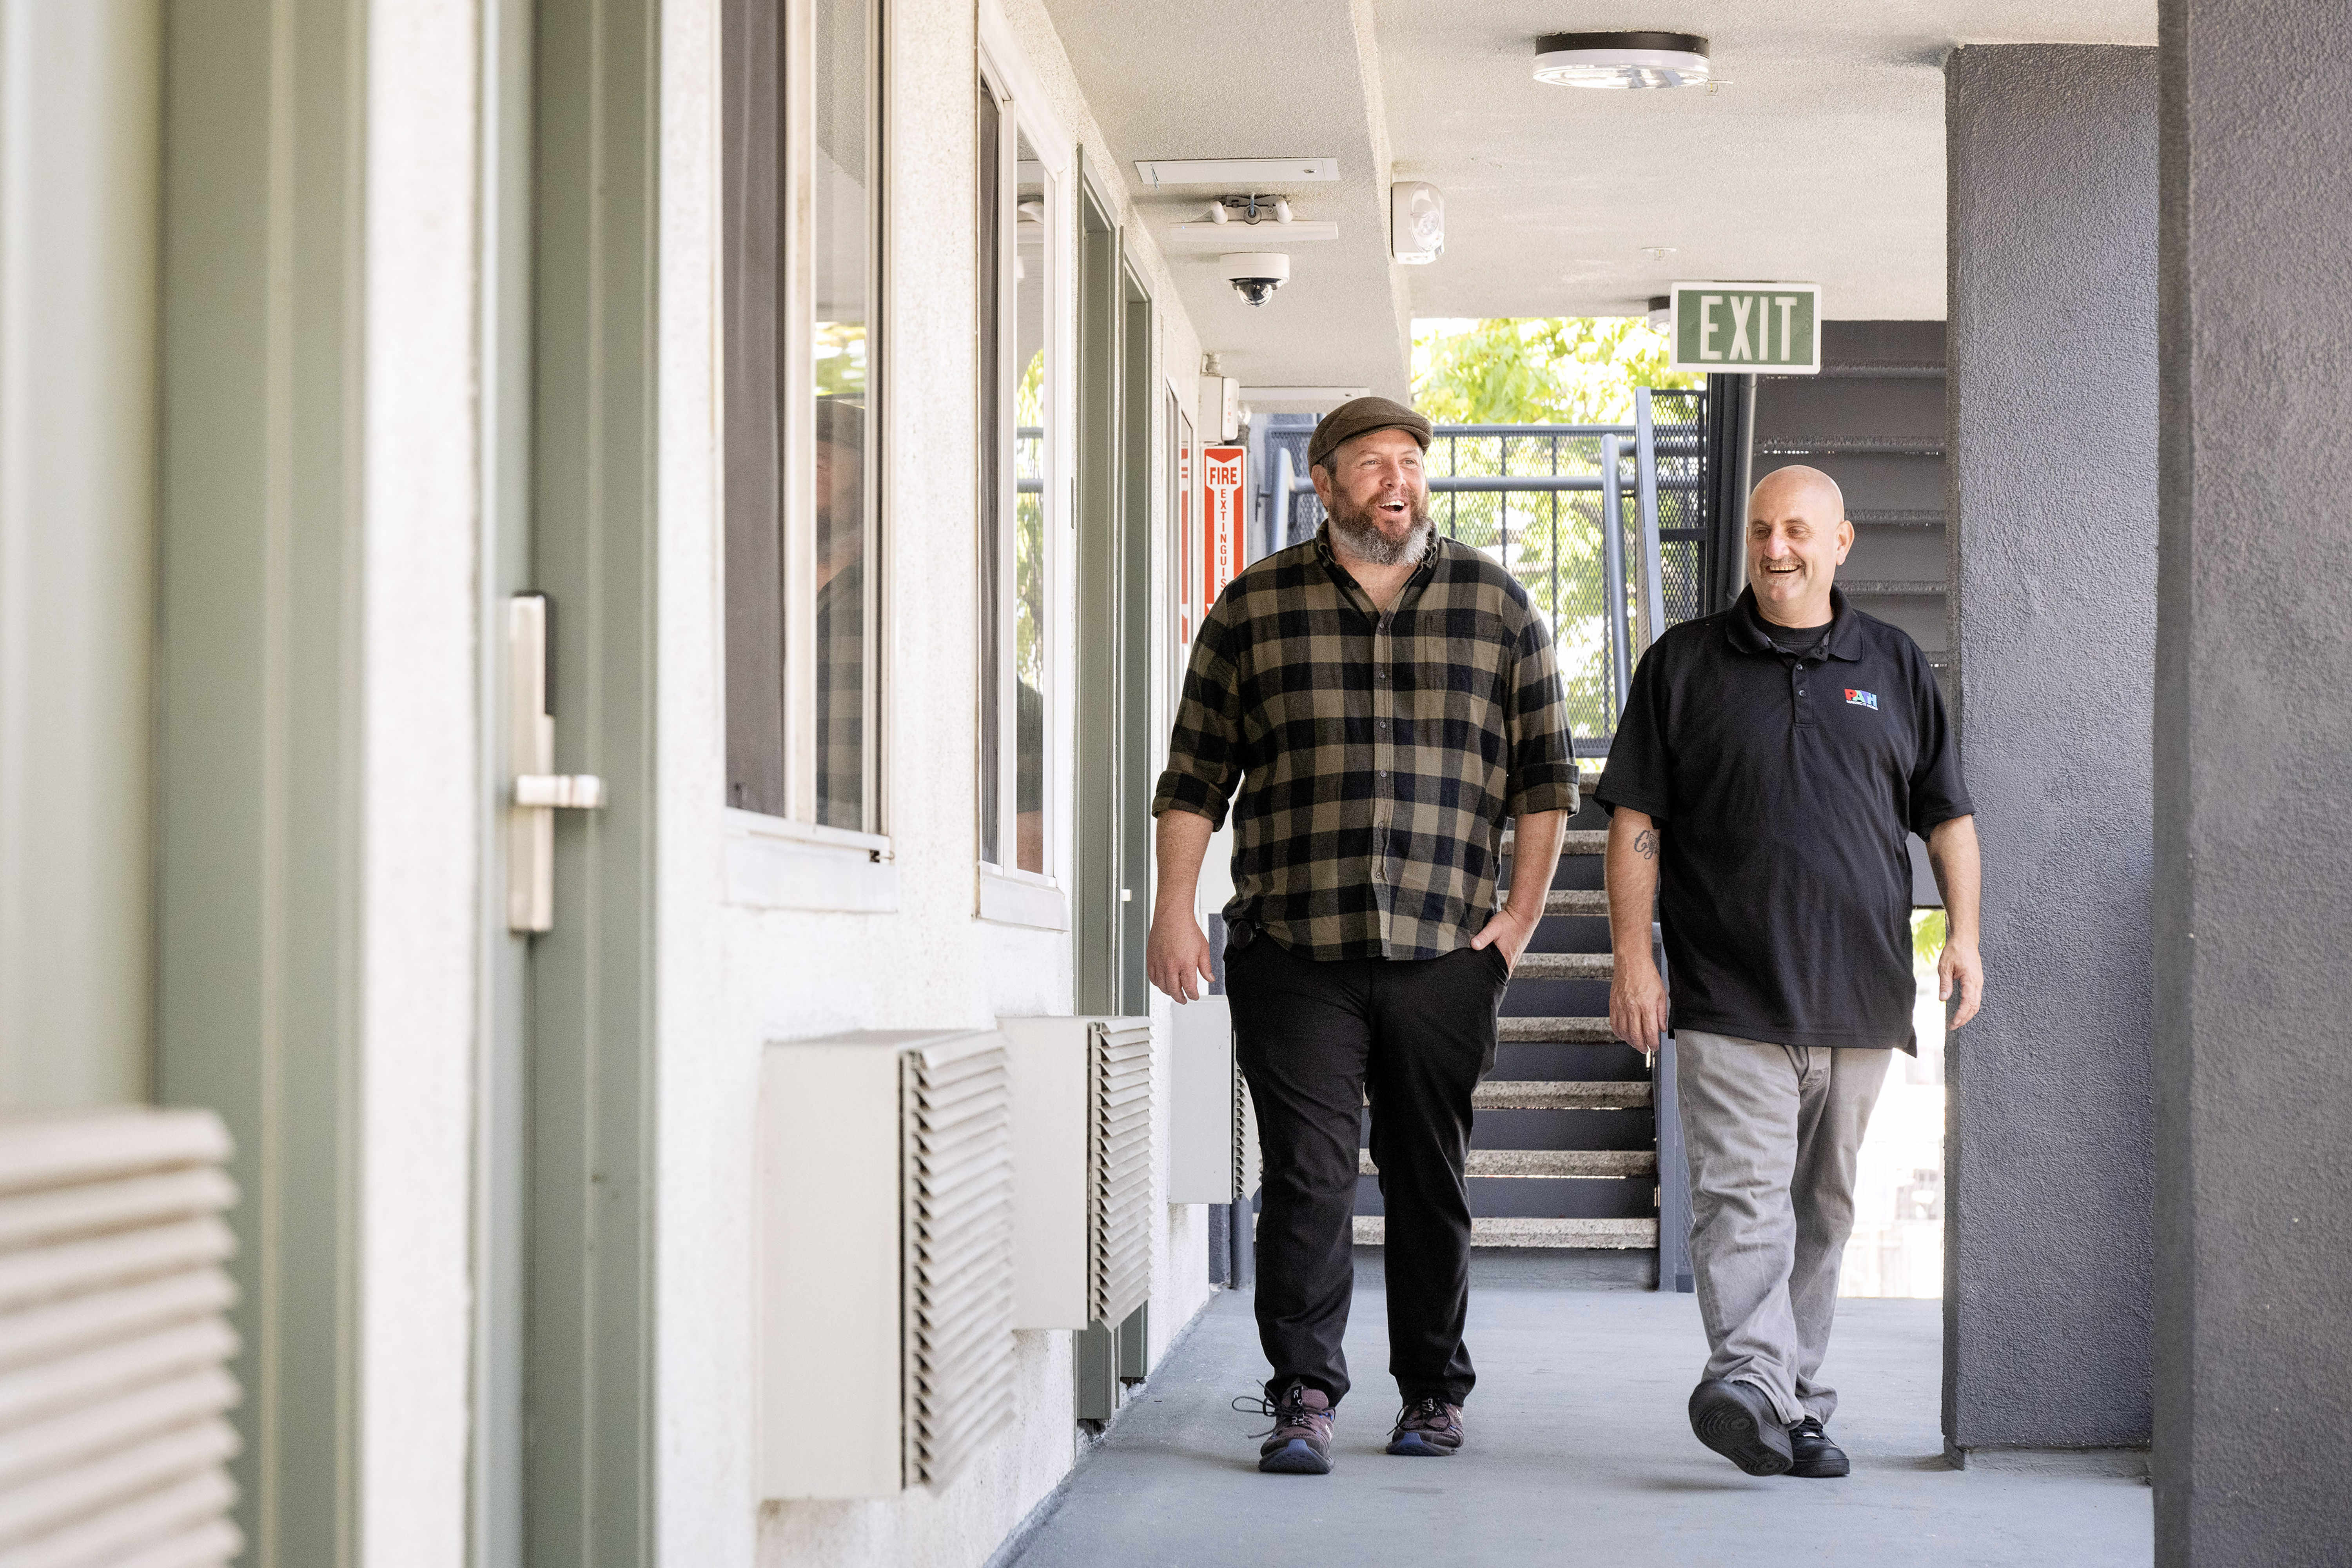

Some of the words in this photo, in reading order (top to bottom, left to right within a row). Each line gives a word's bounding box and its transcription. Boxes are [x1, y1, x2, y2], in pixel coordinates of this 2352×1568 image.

[1700, 296, 1797, 361] EXIT
[1210, 467, 1237, 485] FIRE
[1844, 688, 1878, 707] PATH
